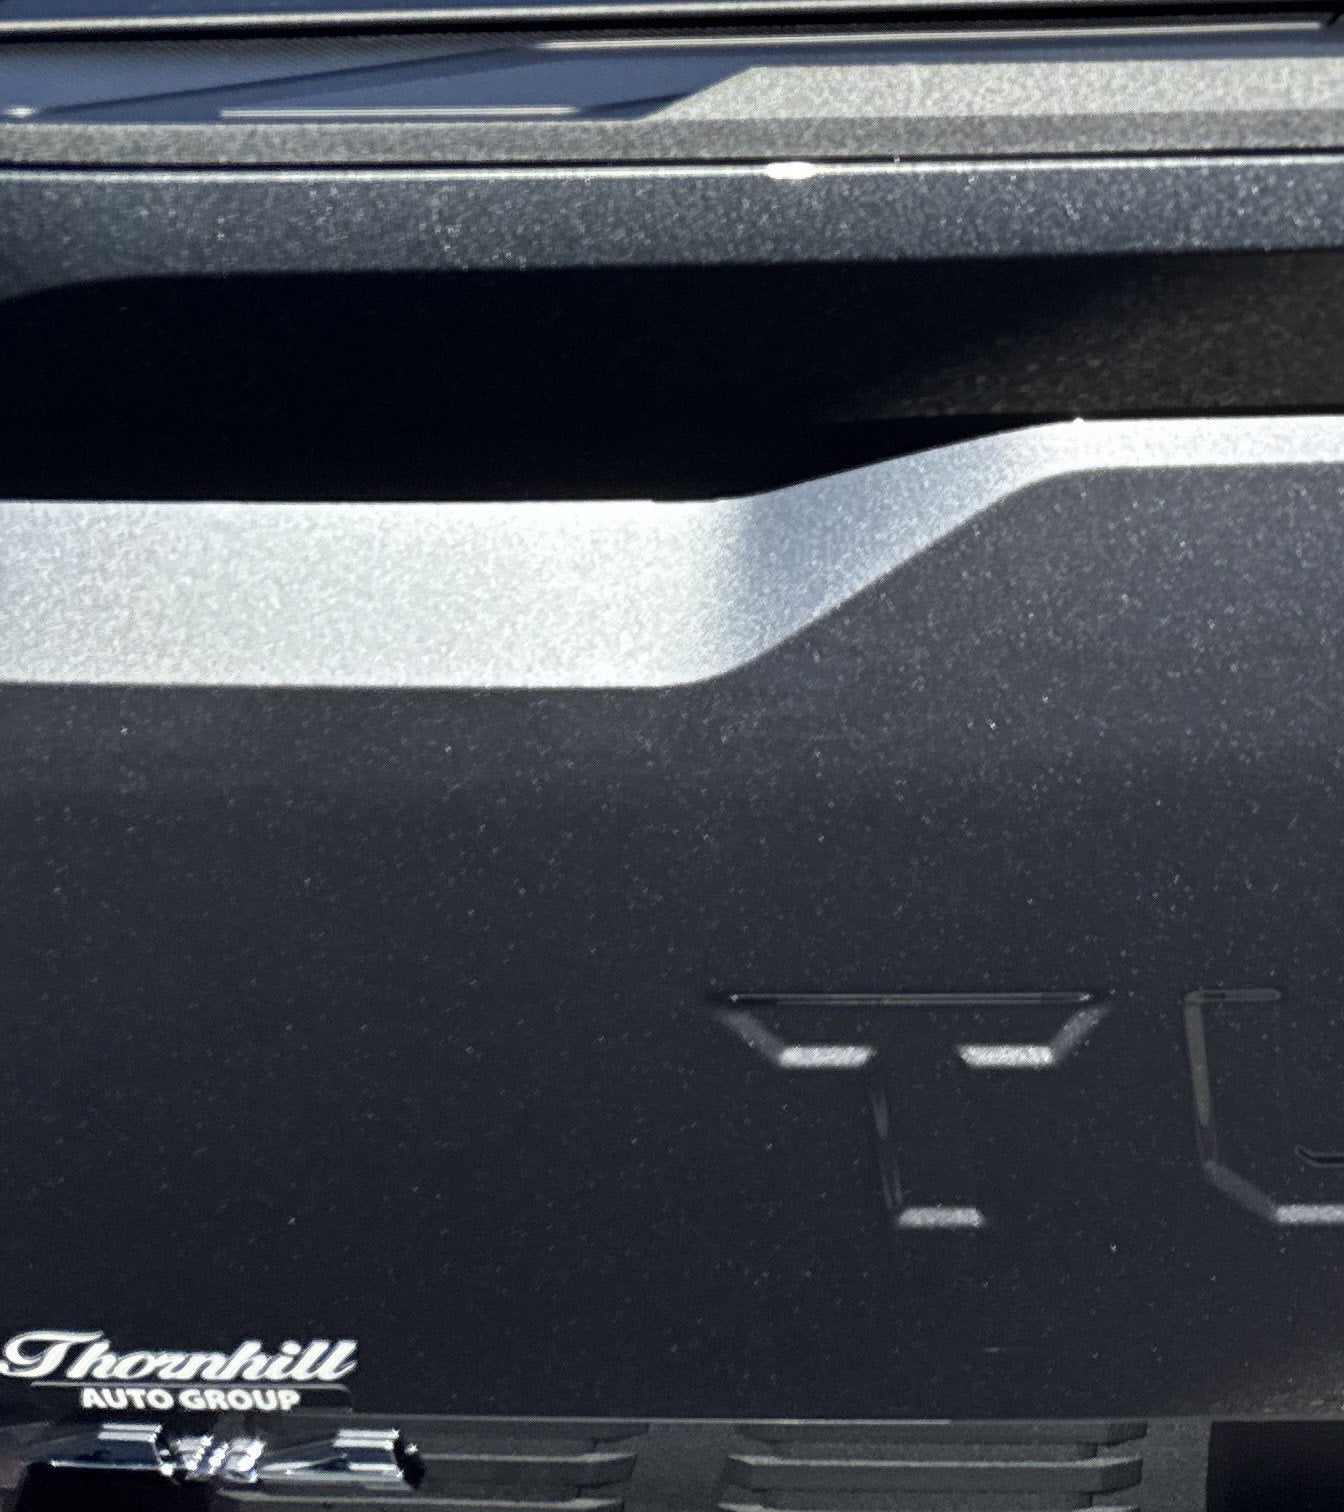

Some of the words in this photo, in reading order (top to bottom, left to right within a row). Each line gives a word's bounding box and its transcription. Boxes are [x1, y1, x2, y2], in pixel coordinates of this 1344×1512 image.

[0, 1330, 359, 1381] Thornhill
[80, 1387, 175, 1410] AUTO
[178, 1388, 301, 1412] GROUP
